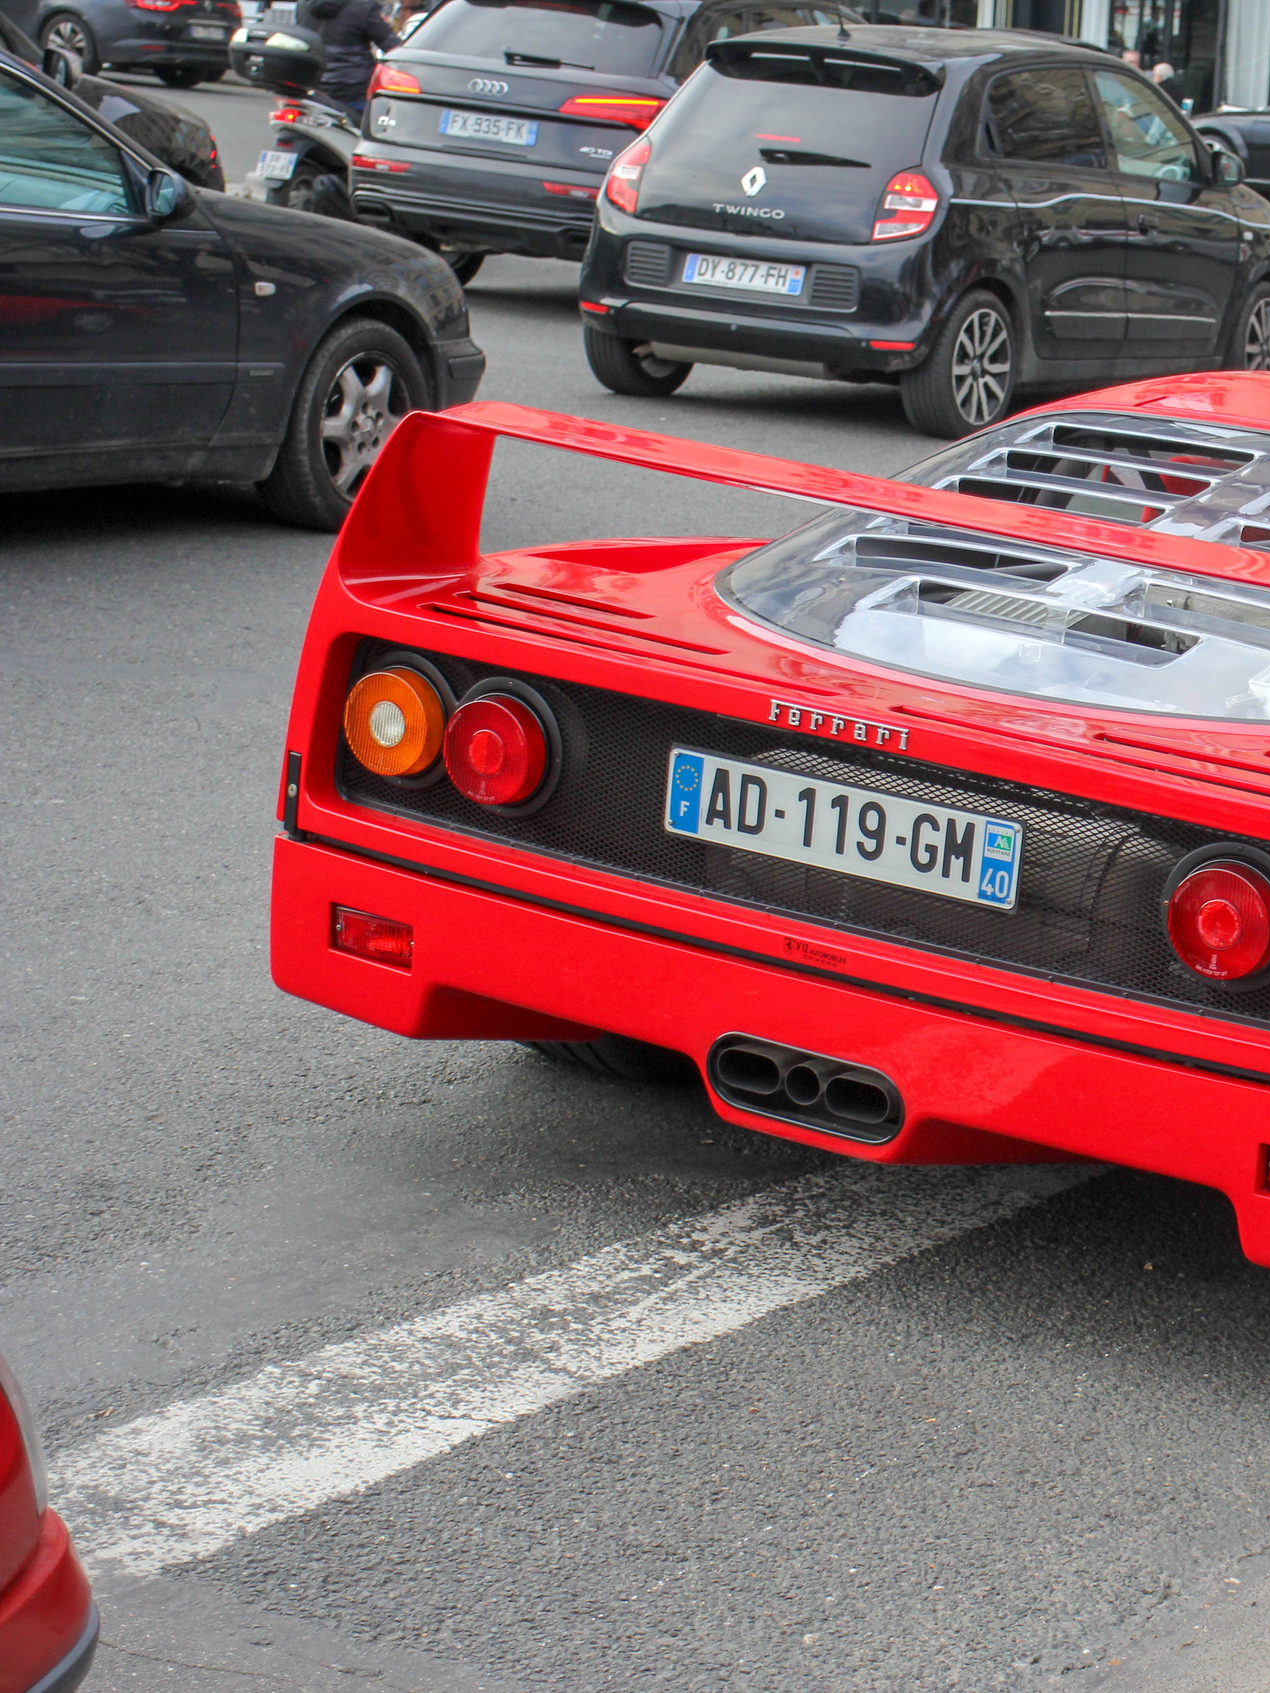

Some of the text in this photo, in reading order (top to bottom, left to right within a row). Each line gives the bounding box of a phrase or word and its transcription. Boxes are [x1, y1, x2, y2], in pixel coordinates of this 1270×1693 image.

[712, 203, 785, 220] TWINGO
[697, 258, 788, 287] DY-877-FH
[768, 699, 910, 751] Ferrari
[680, 800, 690, 817] F
[705, 768, 976, 883] AD-119-GM
[980, 868, 1010, 898] 40
